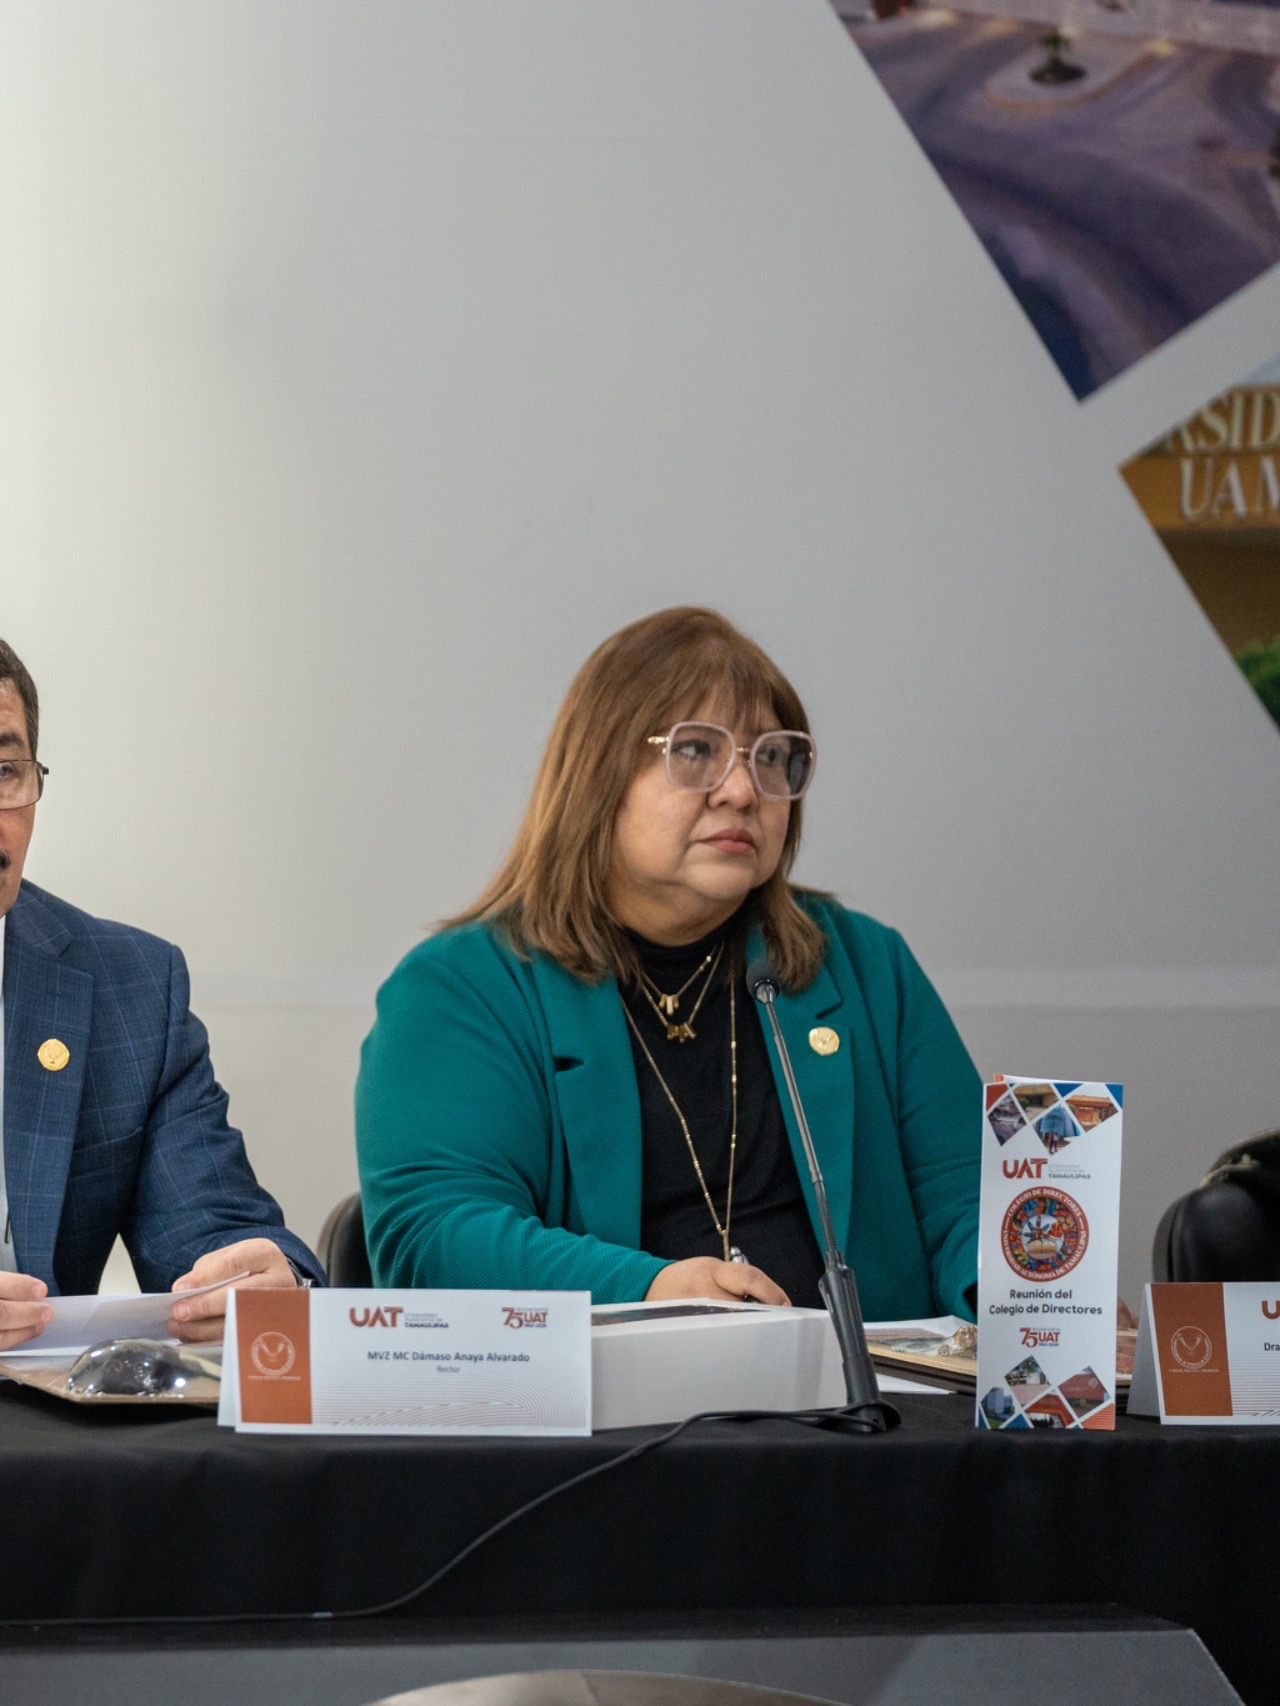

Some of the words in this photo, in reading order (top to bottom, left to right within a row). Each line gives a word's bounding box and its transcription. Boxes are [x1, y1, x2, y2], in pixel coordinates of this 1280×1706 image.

[1002, 1157, 1048, 1179] UAT
[1009, 1288, 1052, 1299] Reunión
[1055, 1289, 1073, 1299] del
[989, 1304, 1024, 1316] Colegio
[1026, 1303, 1040, 1314] de
[1042, 1304, 1103, 1315] Directores
[349, 1305, 404, 1328] UAT
[367, 1351, 391, 1361] MVZ
[393, 1351, 410, 1361] MC
[412, 1351, 452, 1361] Dámaso
[453, 1352, 484, 1363] Anaya
[486, 1352, 531, 1362] Alvarado
[437, 1365, 461, 1373] Rector
